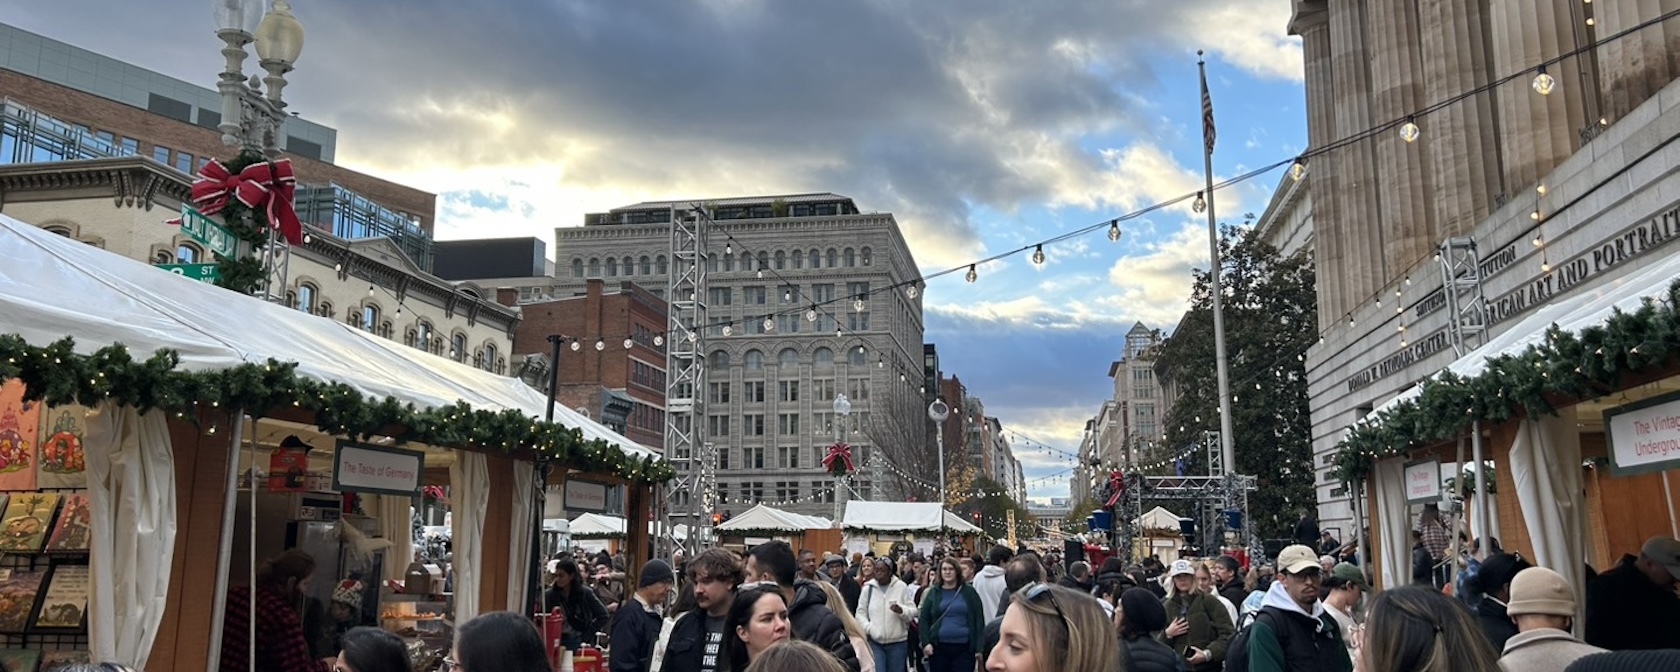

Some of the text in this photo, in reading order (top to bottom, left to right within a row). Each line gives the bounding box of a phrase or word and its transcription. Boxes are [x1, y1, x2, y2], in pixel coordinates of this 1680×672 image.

[201, 266, 214, 275] ST
[1348, 371, 1370, 392] DONALD
[1379, 346, 1415, 376] REYNOLDS
[1415, 330, 1447, 361] CENTER
[1529, 274, 1553, 304] ART
[1557, 258, 1588, 290] AND
[1634, 420, 1650, 436] The
[344, 462, 415, 481] The Taste of Germany
